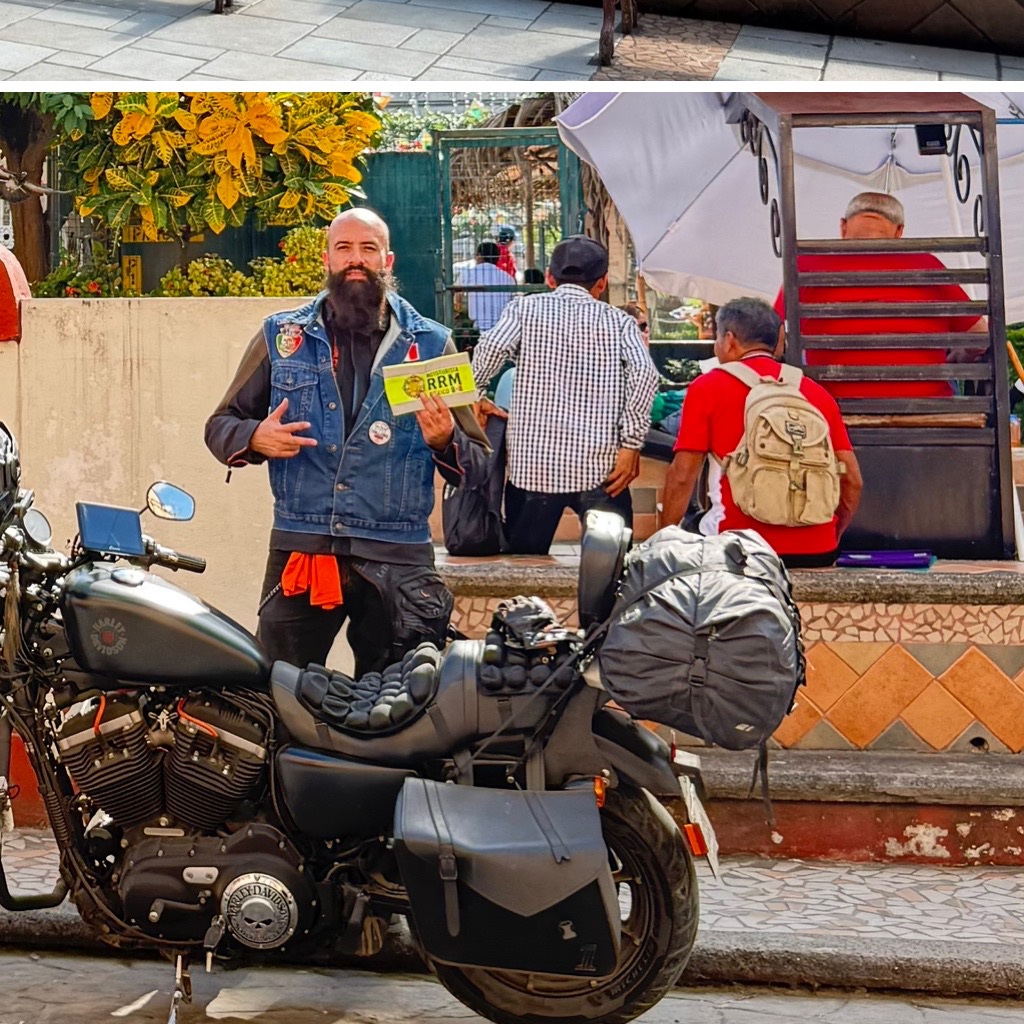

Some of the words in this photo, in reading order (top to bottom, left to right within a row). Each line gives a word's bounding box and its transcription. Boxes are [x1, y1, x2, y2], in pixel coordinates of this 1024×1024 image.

[427, 372, 461, 390] RRM
[92, 617, 126, 632] HARLEY
[90, 633, 127, 656] DAVIDSON
